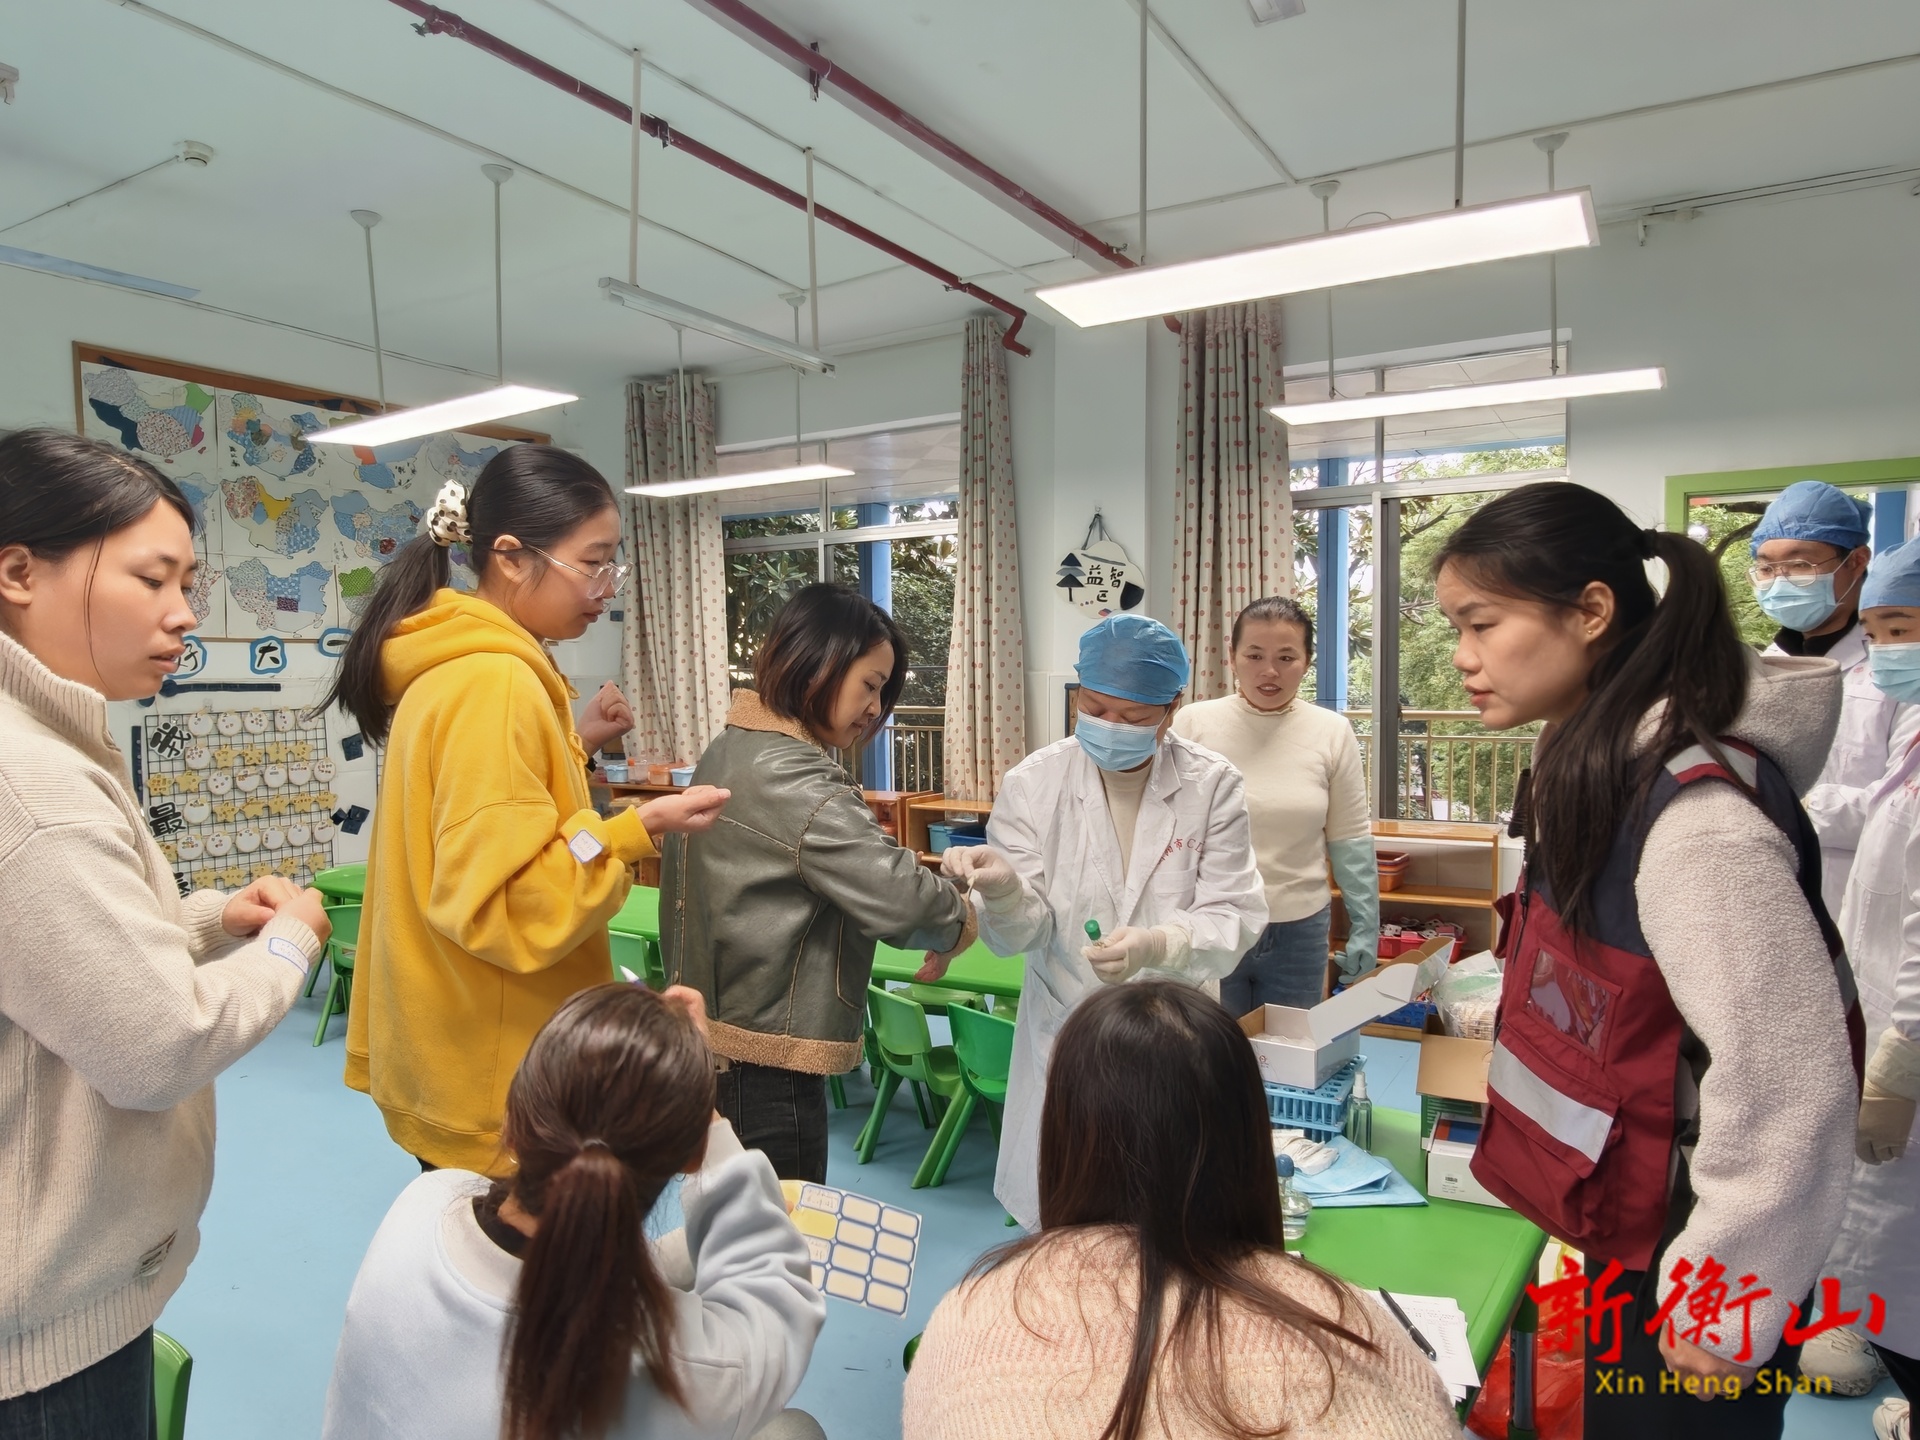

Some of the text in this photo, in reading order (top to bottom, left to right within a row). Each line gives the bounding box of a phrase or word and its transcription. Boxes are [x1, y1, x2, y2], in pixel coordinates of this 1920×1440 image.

[1086, 565, 1124, 588] 益智
[1096, 590, 1109, 602] 区
[257, 643, 281, 668] 大
[149, 722, 191, 837] 我 最
